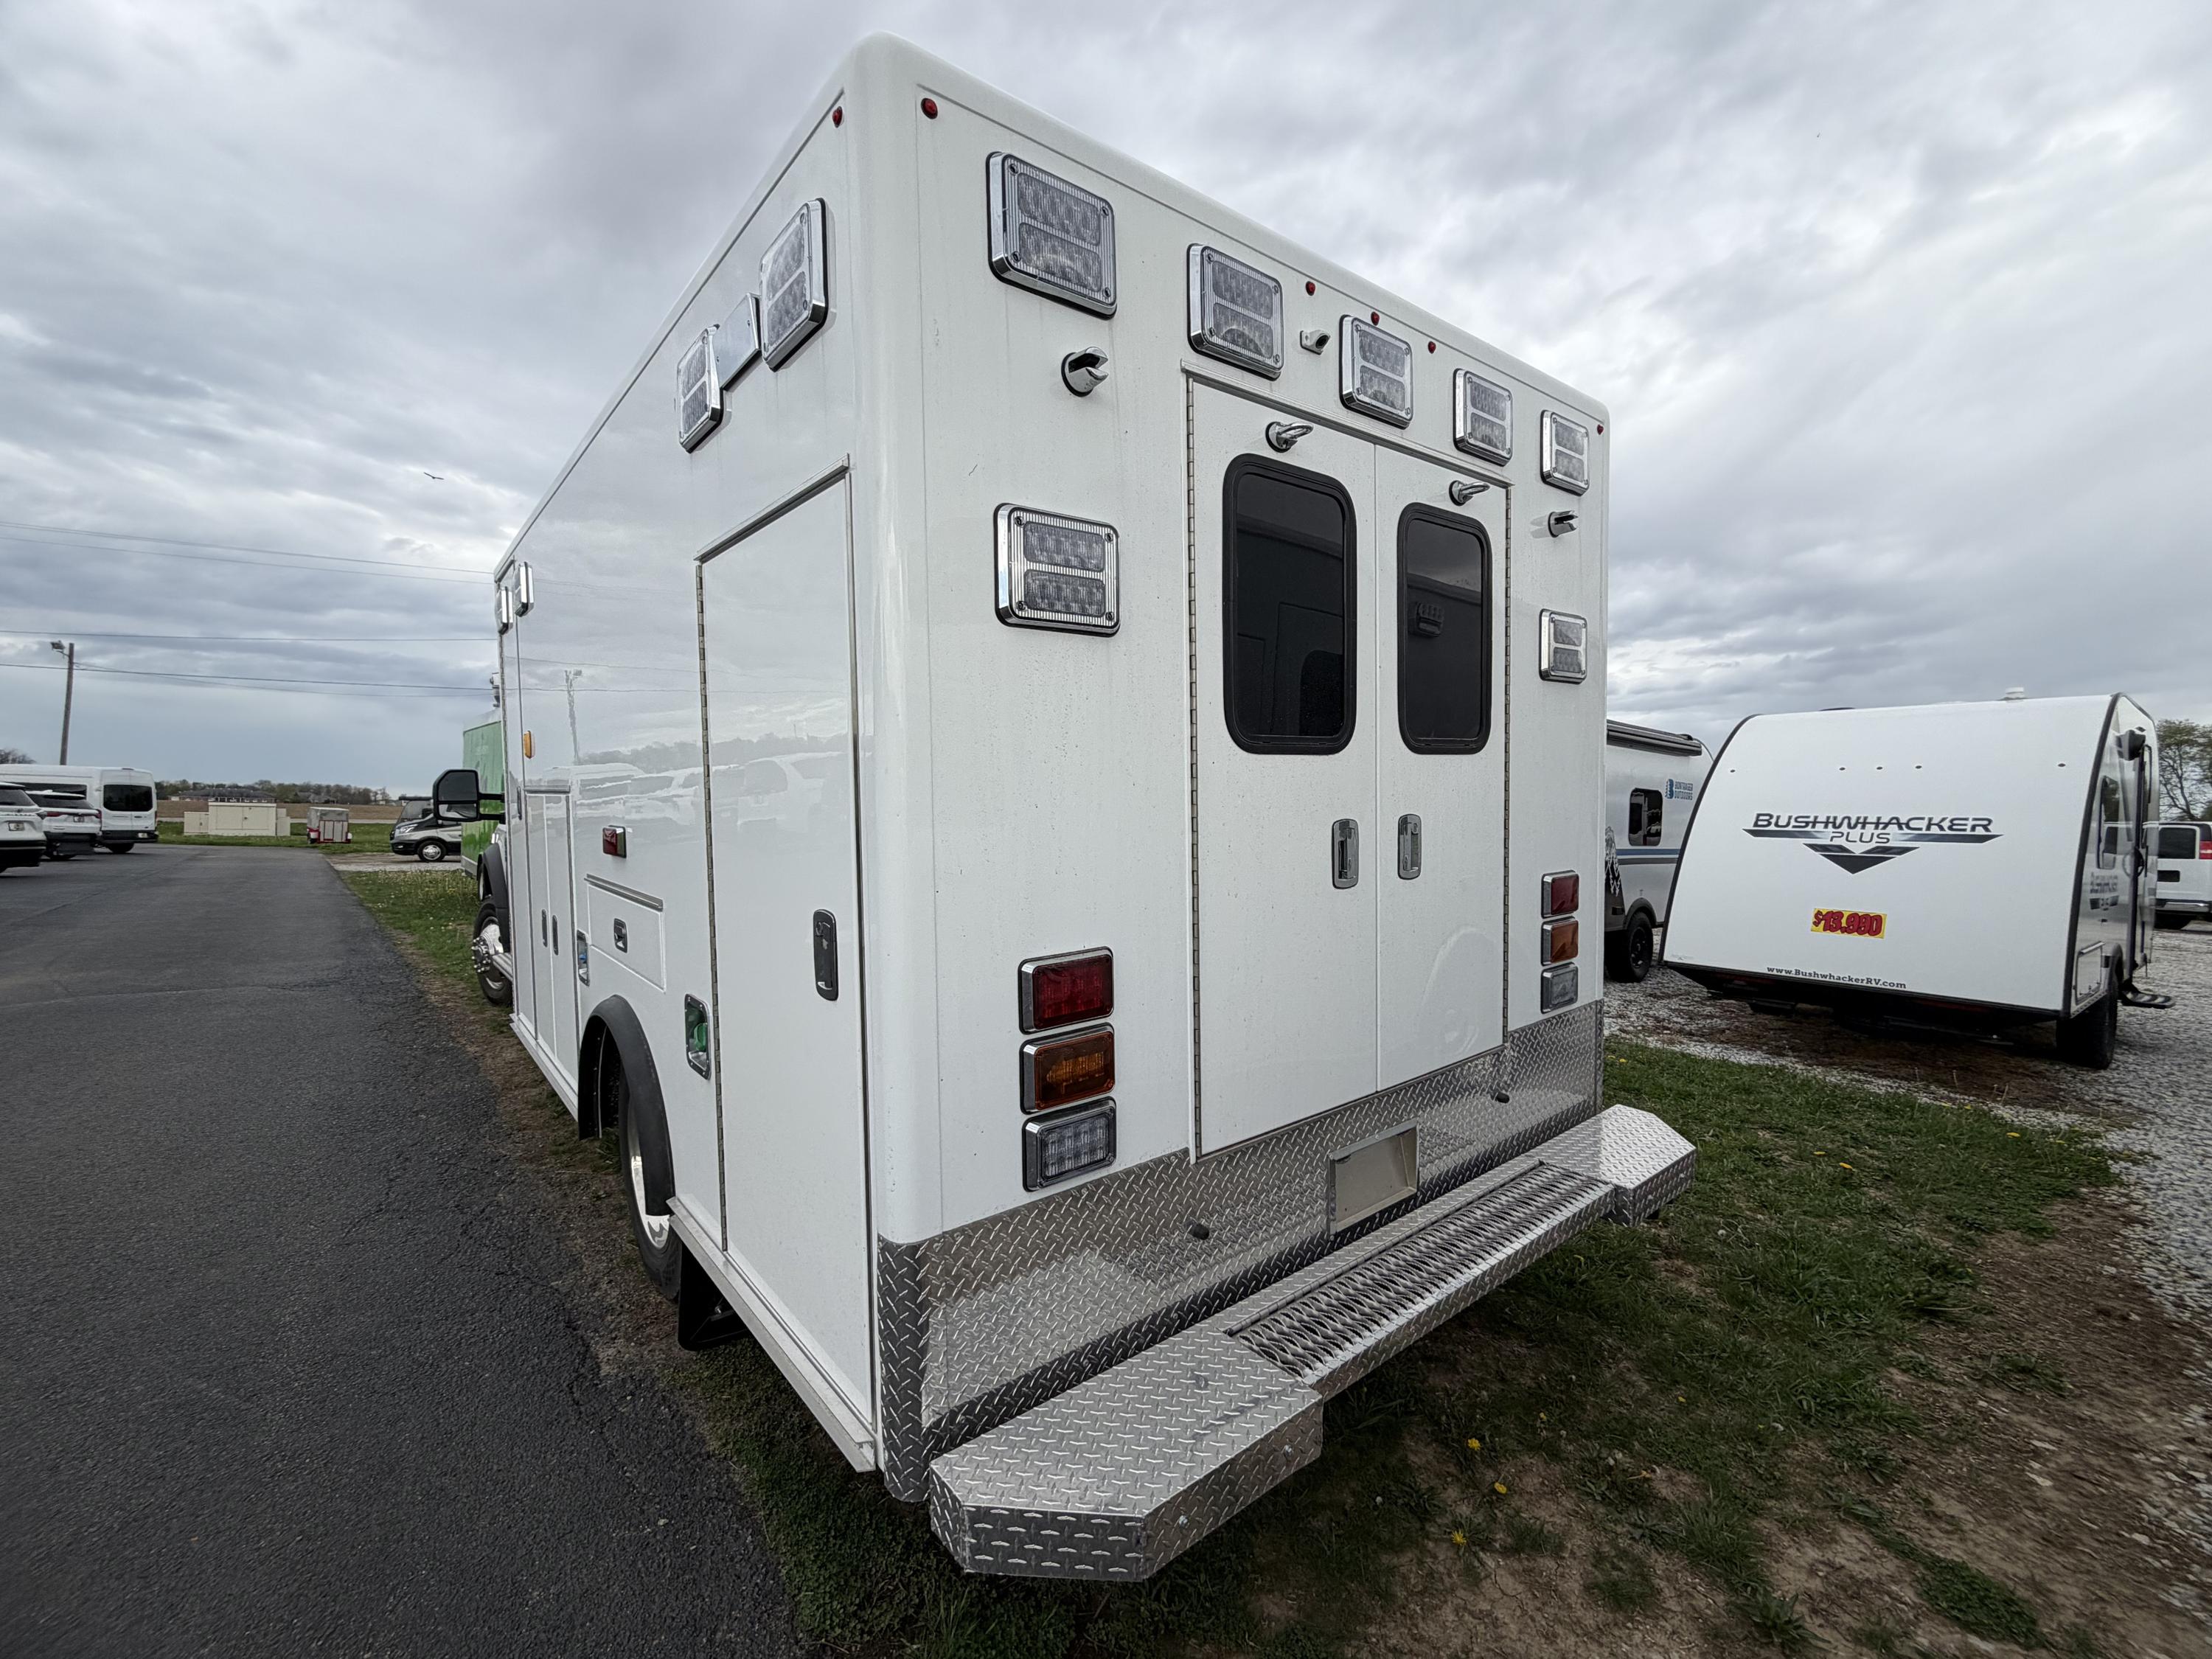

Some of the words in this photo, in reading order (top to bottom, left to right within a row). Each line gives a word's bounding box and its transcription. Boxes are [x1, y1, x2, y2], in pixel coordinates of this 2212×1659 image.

[1753, 813, 1994, 832] BUSHWHACKER
[1829, 831, 1891, 844] PLUS
[1767, 967, 1907, 989] www.BushwhackerRV.com
